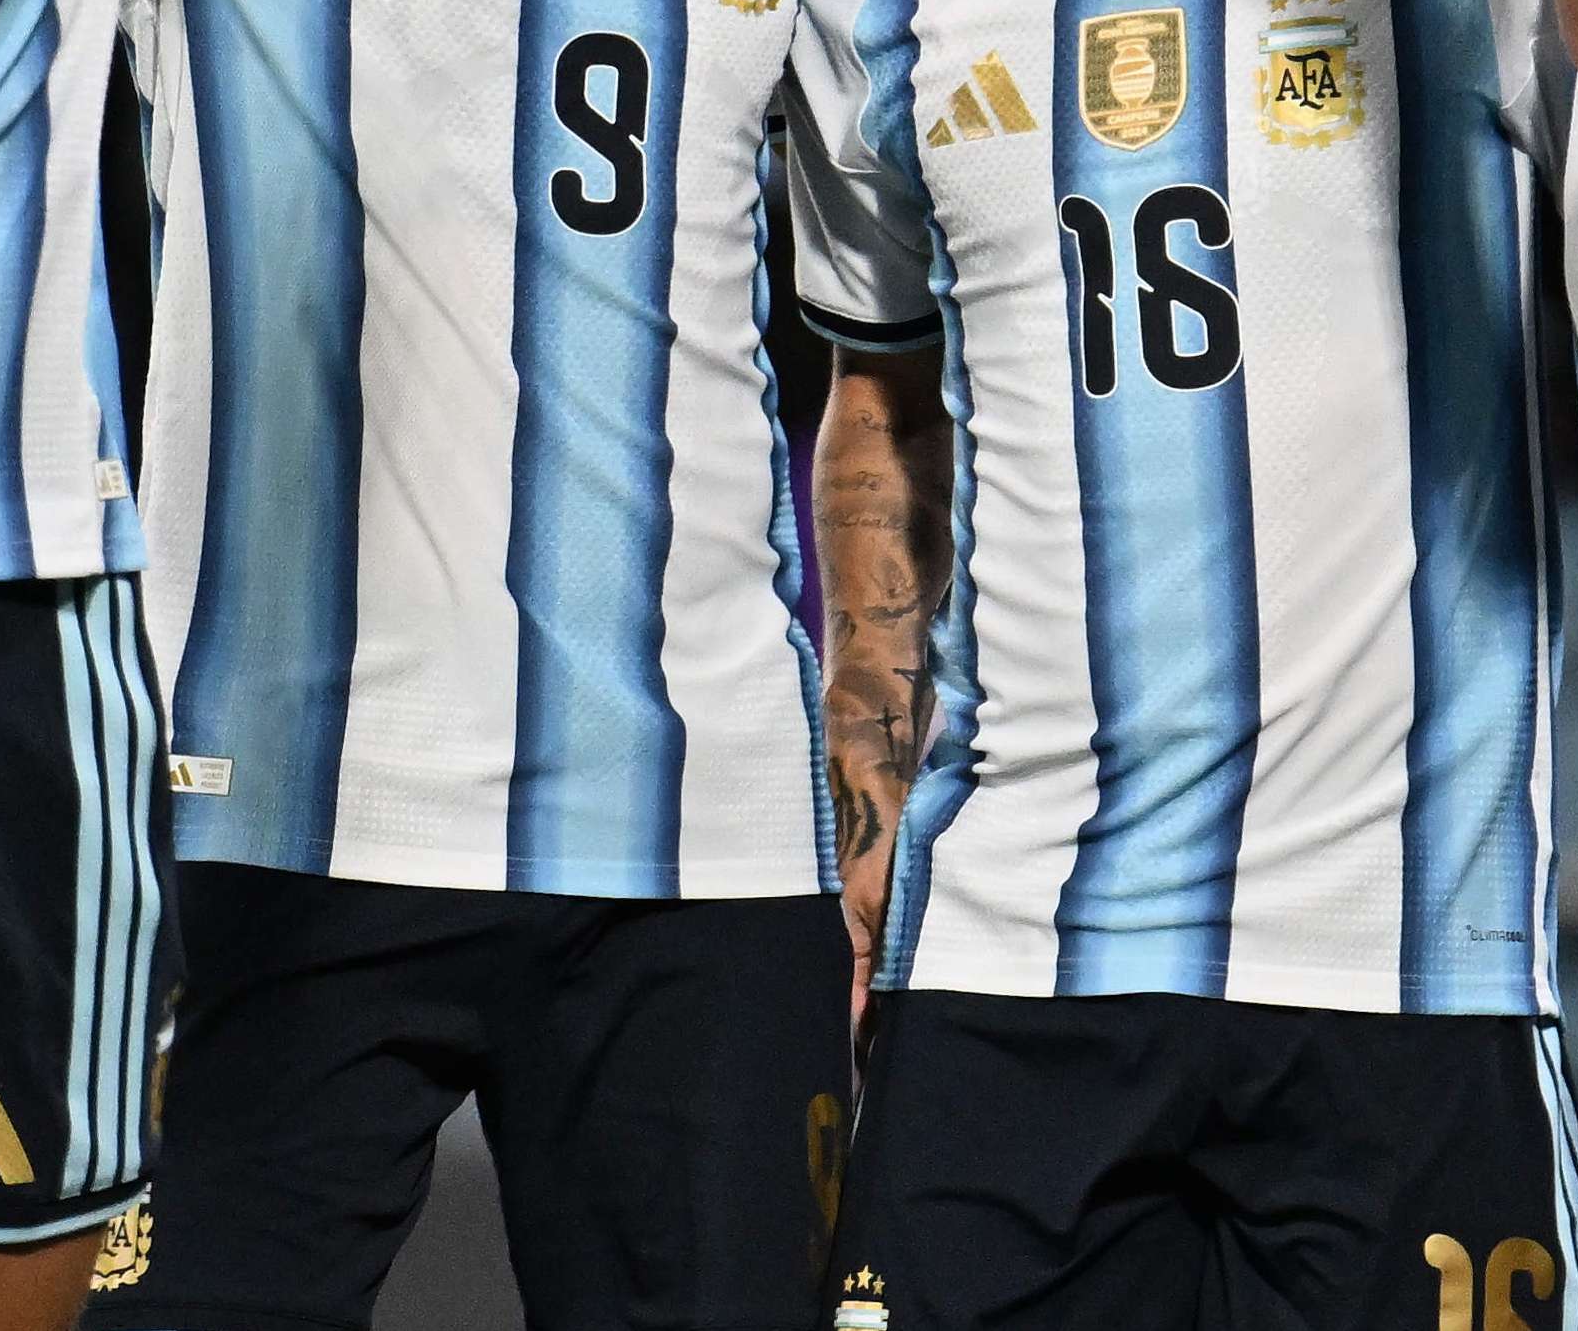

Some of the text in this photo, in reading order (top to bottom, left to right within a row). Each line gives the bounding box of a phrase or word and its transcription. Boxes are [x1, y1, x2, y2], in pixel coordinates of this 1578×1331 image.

[550, 31, 651, 237] 9
[1275, 50, 1342, 110] AFA
[1058, 183, 1244, 399] 16
